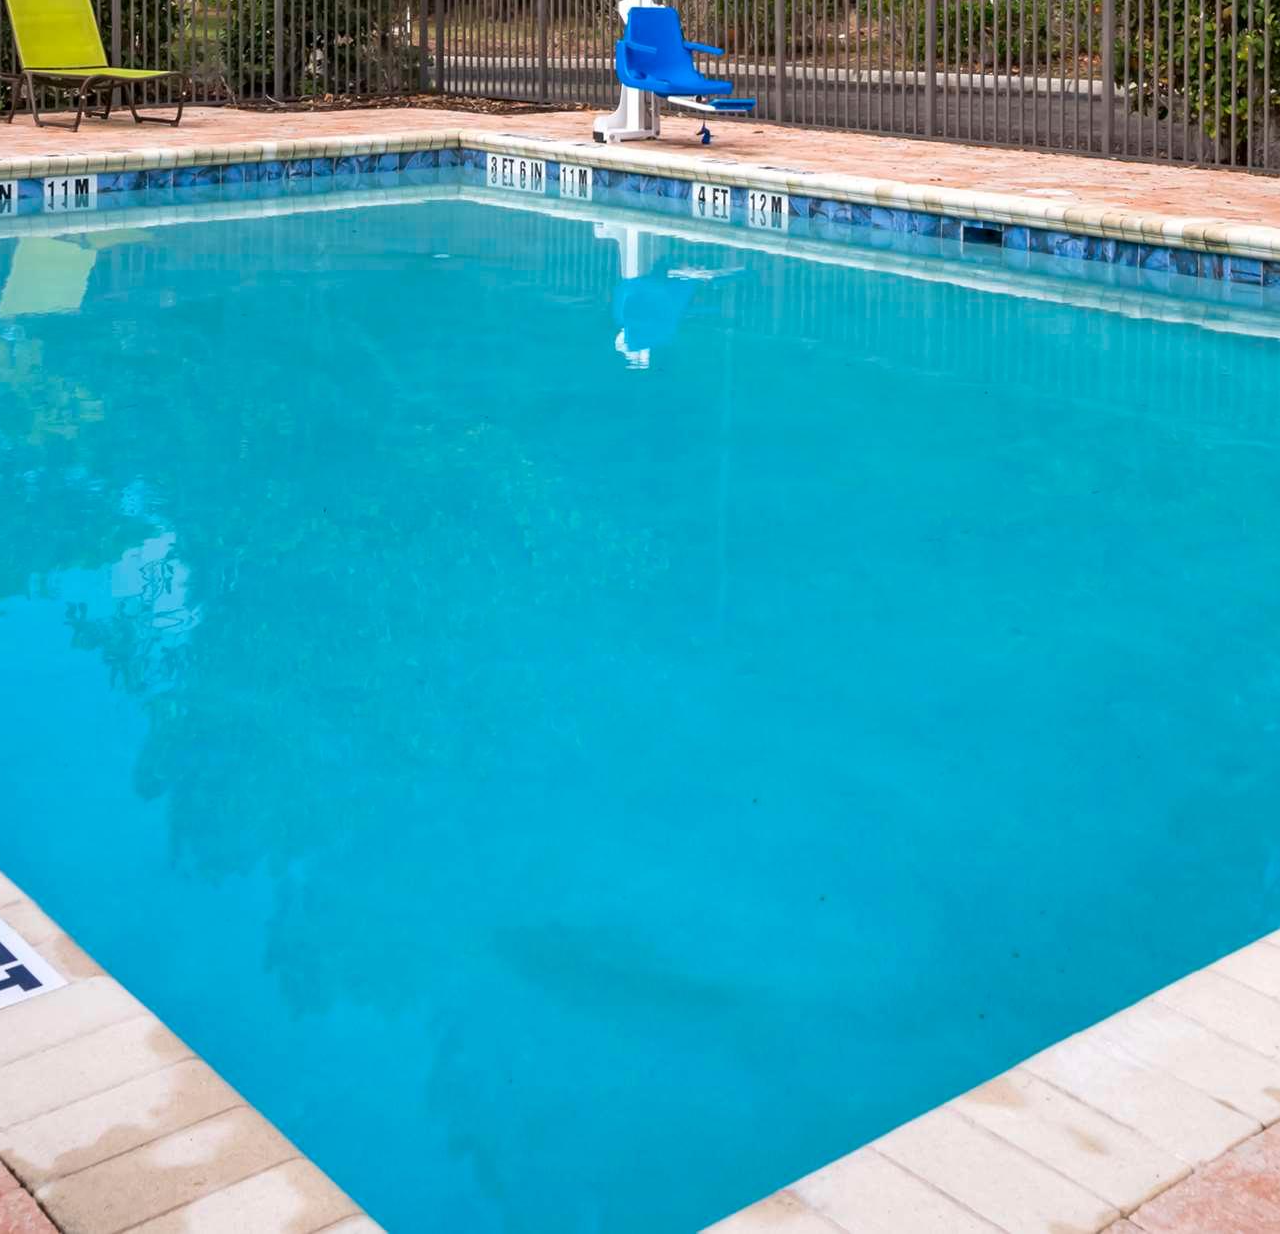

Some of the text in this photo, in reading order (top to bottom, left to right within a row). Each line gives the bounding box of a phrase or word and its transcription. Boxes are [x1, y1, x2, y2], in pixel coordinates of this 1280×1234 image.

[531, 162, 542, 178] IN
[698, 186, 728, 205] 4 FT
